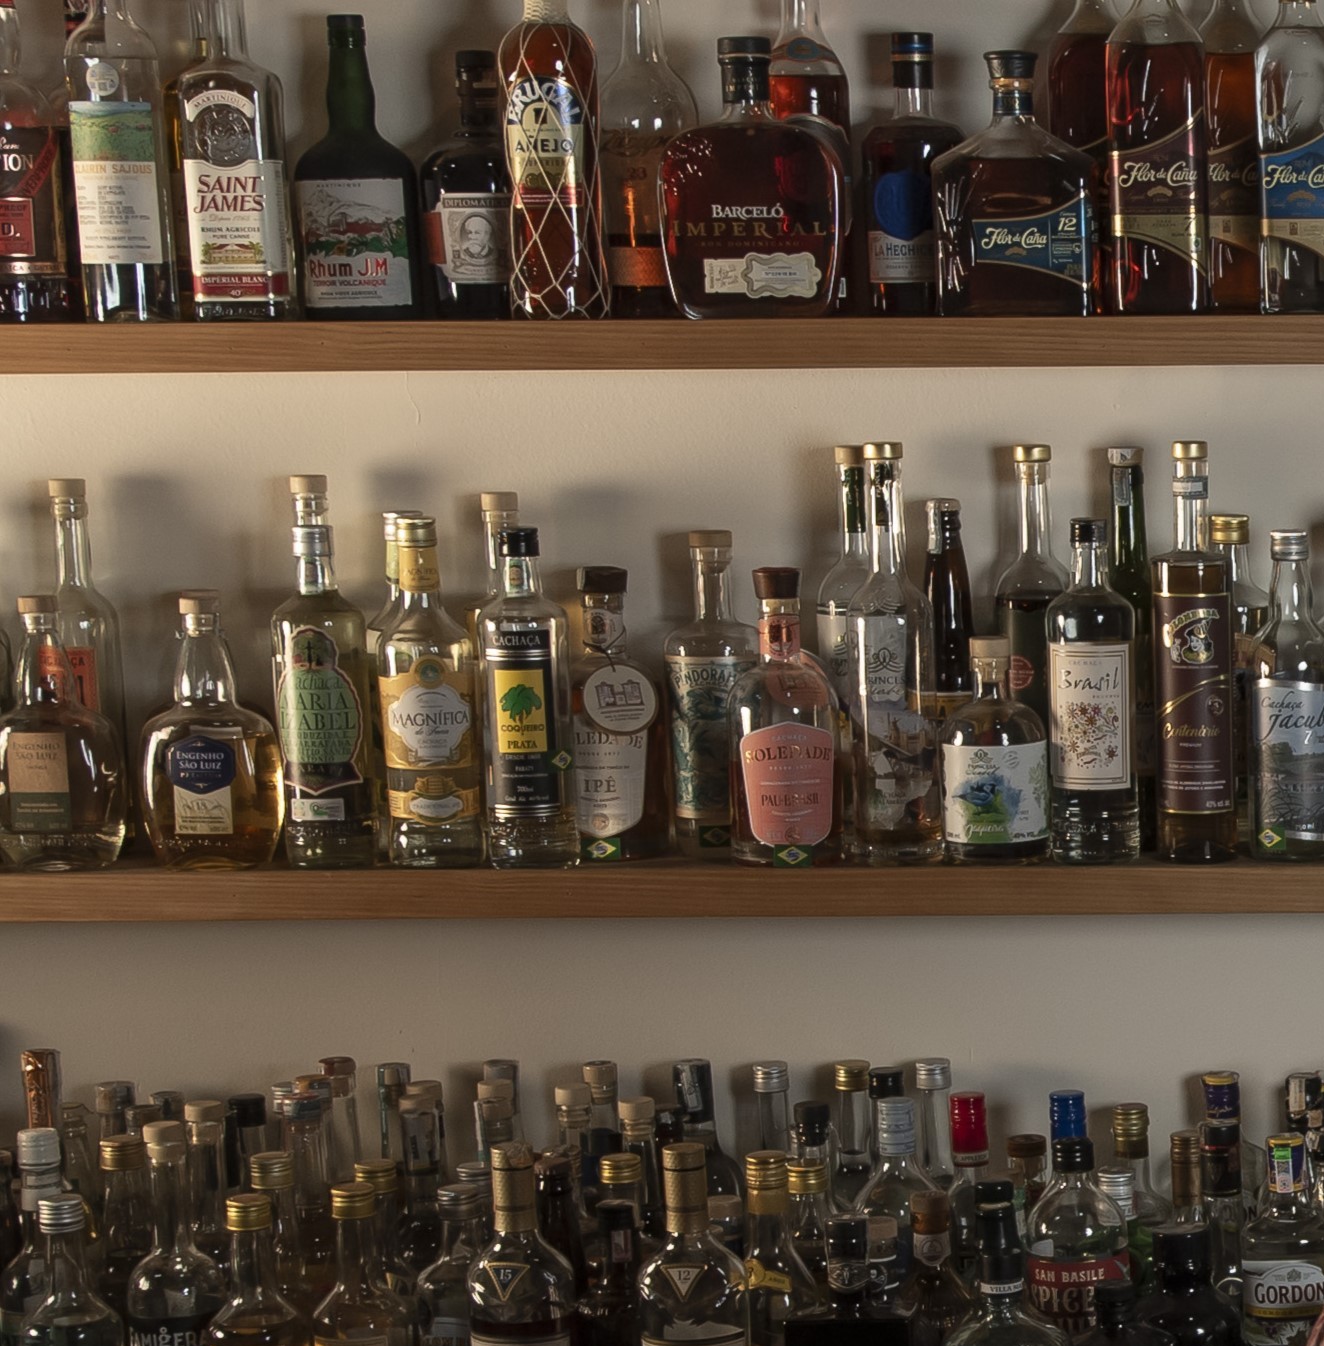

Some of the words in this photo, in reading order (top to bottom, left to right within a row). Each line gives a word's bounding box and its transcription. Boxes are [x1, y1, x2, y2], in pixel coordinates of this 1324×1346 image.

[515, 137, 574, 153] AÑEJO
[1120, 162, 1153, 187] Flor
[1167, 161, 1198, 187] Caña
[1263, 164, 1296, 188] Flor
[1297, 173, 1309, 182] de
[197, 174, 260, 194] SAINT
[194, 194, 266, 214] JAMES
[711, 203, 785, 219] BARCELÓ
[673, 221, 828, 239] IMPERIAL
[1058, 218, 1077, 231] 12
[982, 227, 1011, 249] Flor
[1021, 227, 1047, 249] Caña
[310, 257, 352, 278] Rhum
[492, 634, 541, 647] CACHAÇA
[673, 668, 734, 690] PINDORA
[1058, 666, 1120, 692] Brasil
[393, 709, 470, 730] MAGNÍFICA
[501, 724, 546, 733] COQUEIRO
[507, 738, 538, 751] PRATA
[1303, 730, 1313, 745] 7
[176, 751, 225, 761] ENGENHO
[180, 759, 198, 770] SÃO
[200, 760, 223, 770] LUIZ
[583, 775, 618, 793] IPÊ
[761, 792, 819, 807] PAU-BSIL
[676, 1270, 692, 1281] 12
[1034, 1267, 1055, 1283] SAN
[1061, 1267, 1105, 1283] BASILE
